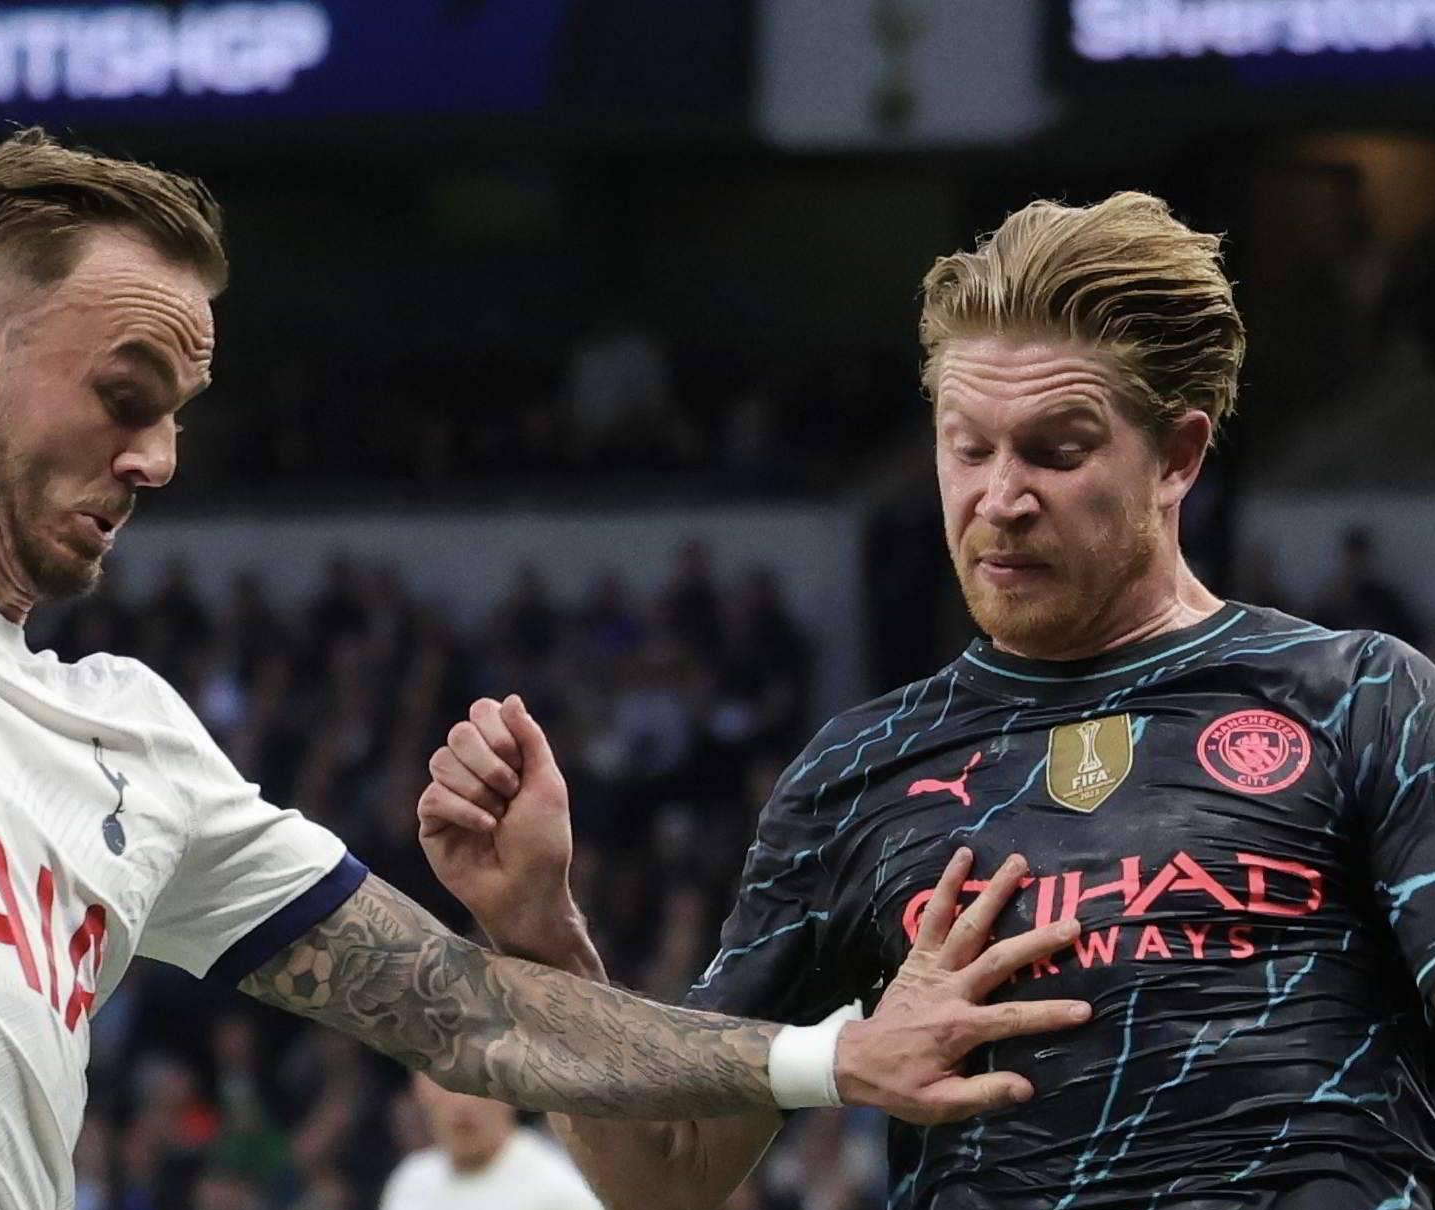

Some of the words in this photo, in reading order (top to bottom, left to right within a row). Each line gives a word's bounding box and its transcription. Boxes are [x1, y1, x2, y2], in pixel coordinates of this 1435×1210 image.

[1211, 716, 1297, 740] MANCHESTER
[1072, 769, 1108, 789] FIFA
[1237, 775, 1269, 786] CITY
[1012, 924, 1256, 980] WAYS
